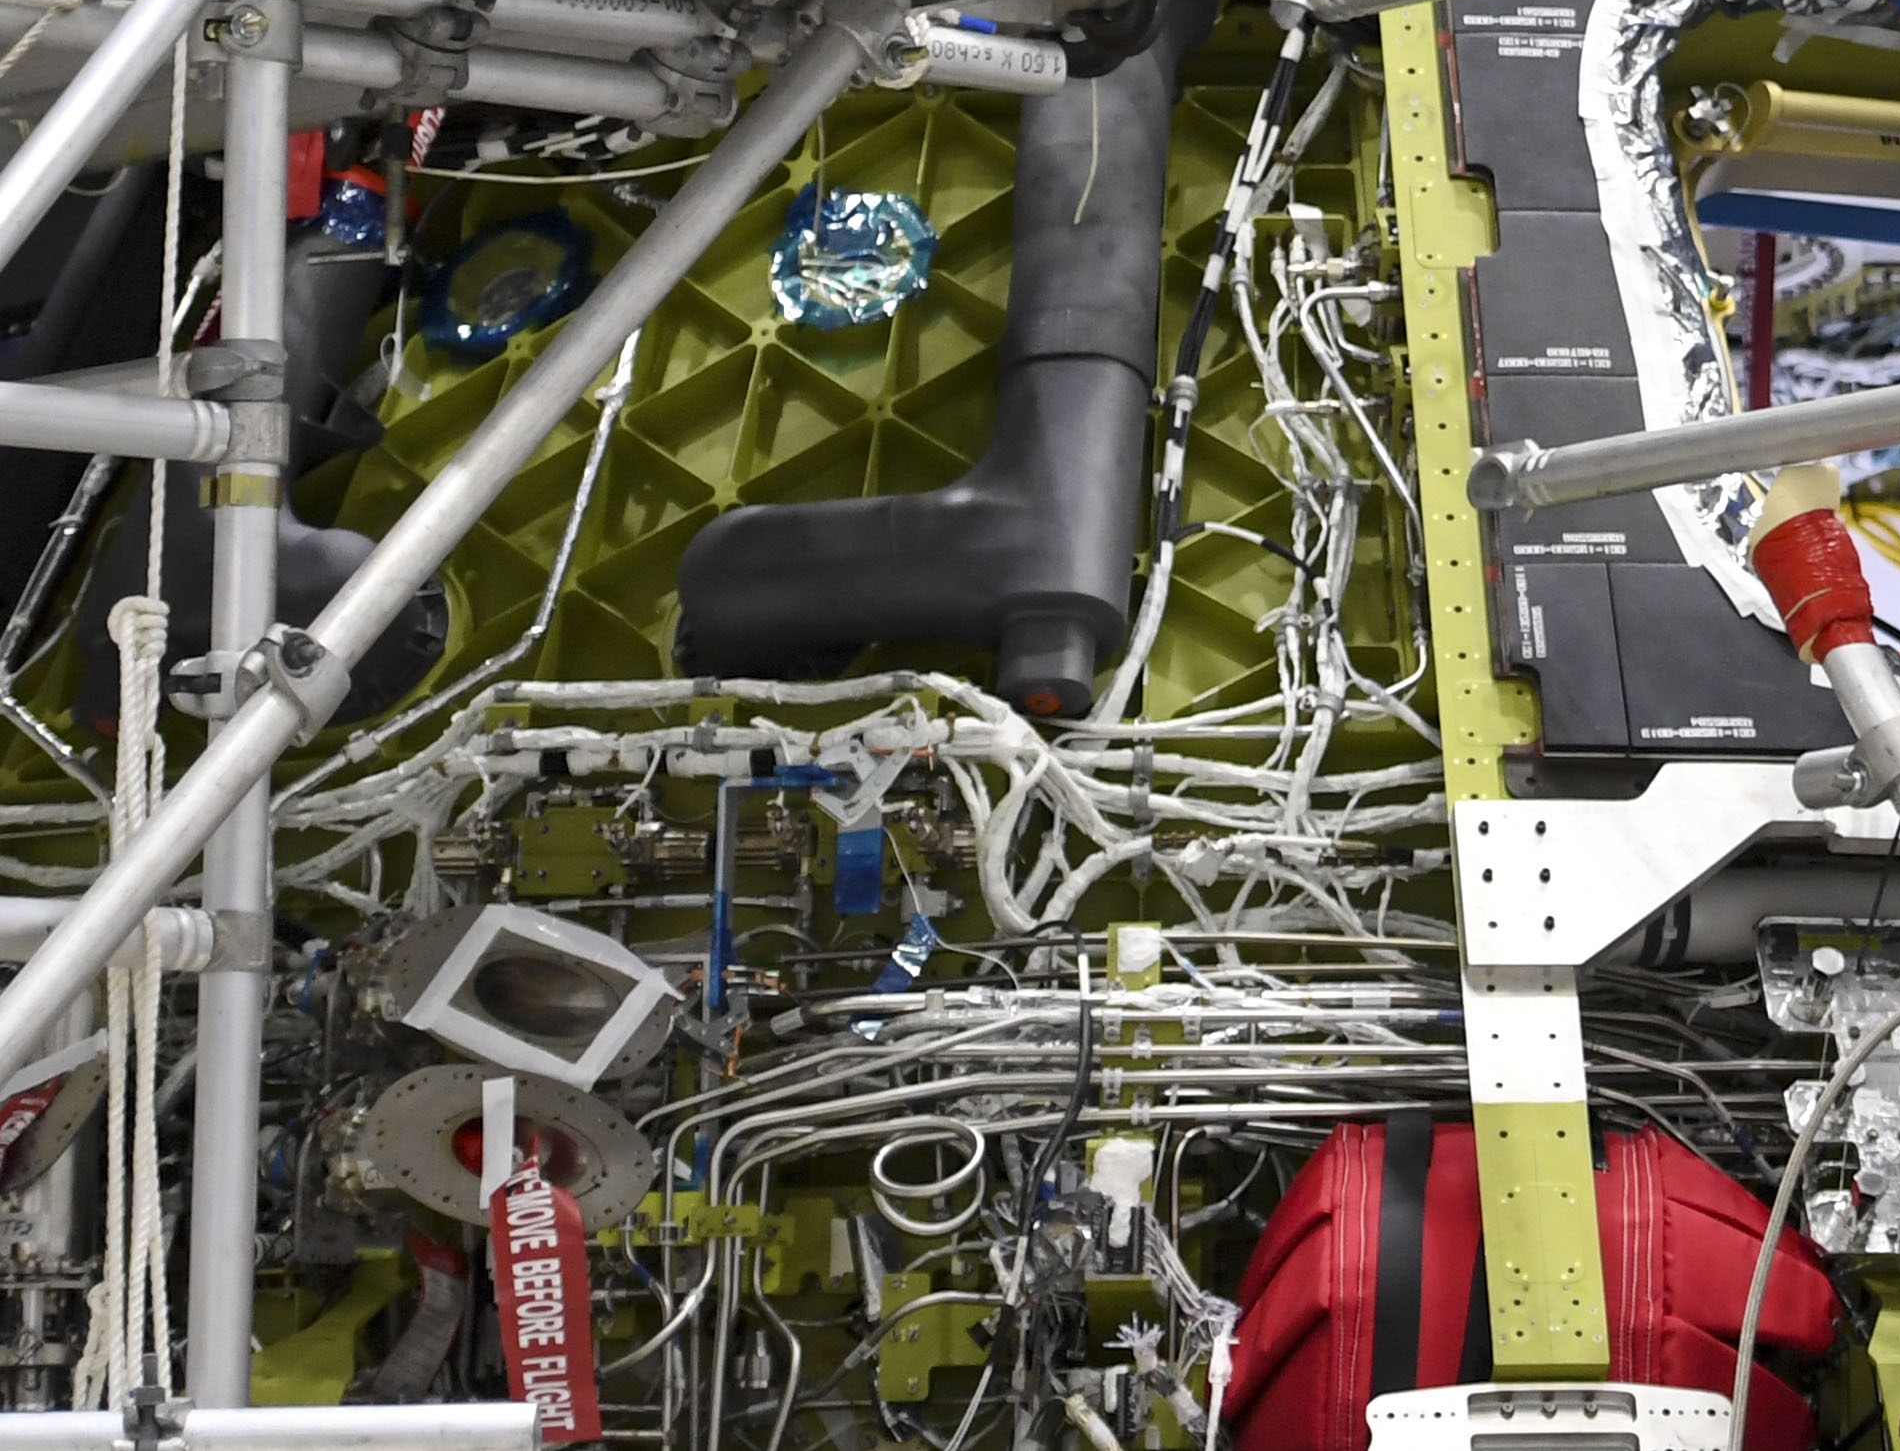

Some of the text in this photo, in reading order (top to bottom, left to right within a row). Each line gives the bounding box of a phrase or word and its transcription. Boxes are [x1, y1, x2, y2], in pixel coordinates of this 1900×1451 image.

[505, 1167, 576, 1432] REMOVE BEFORE FLIGHT
